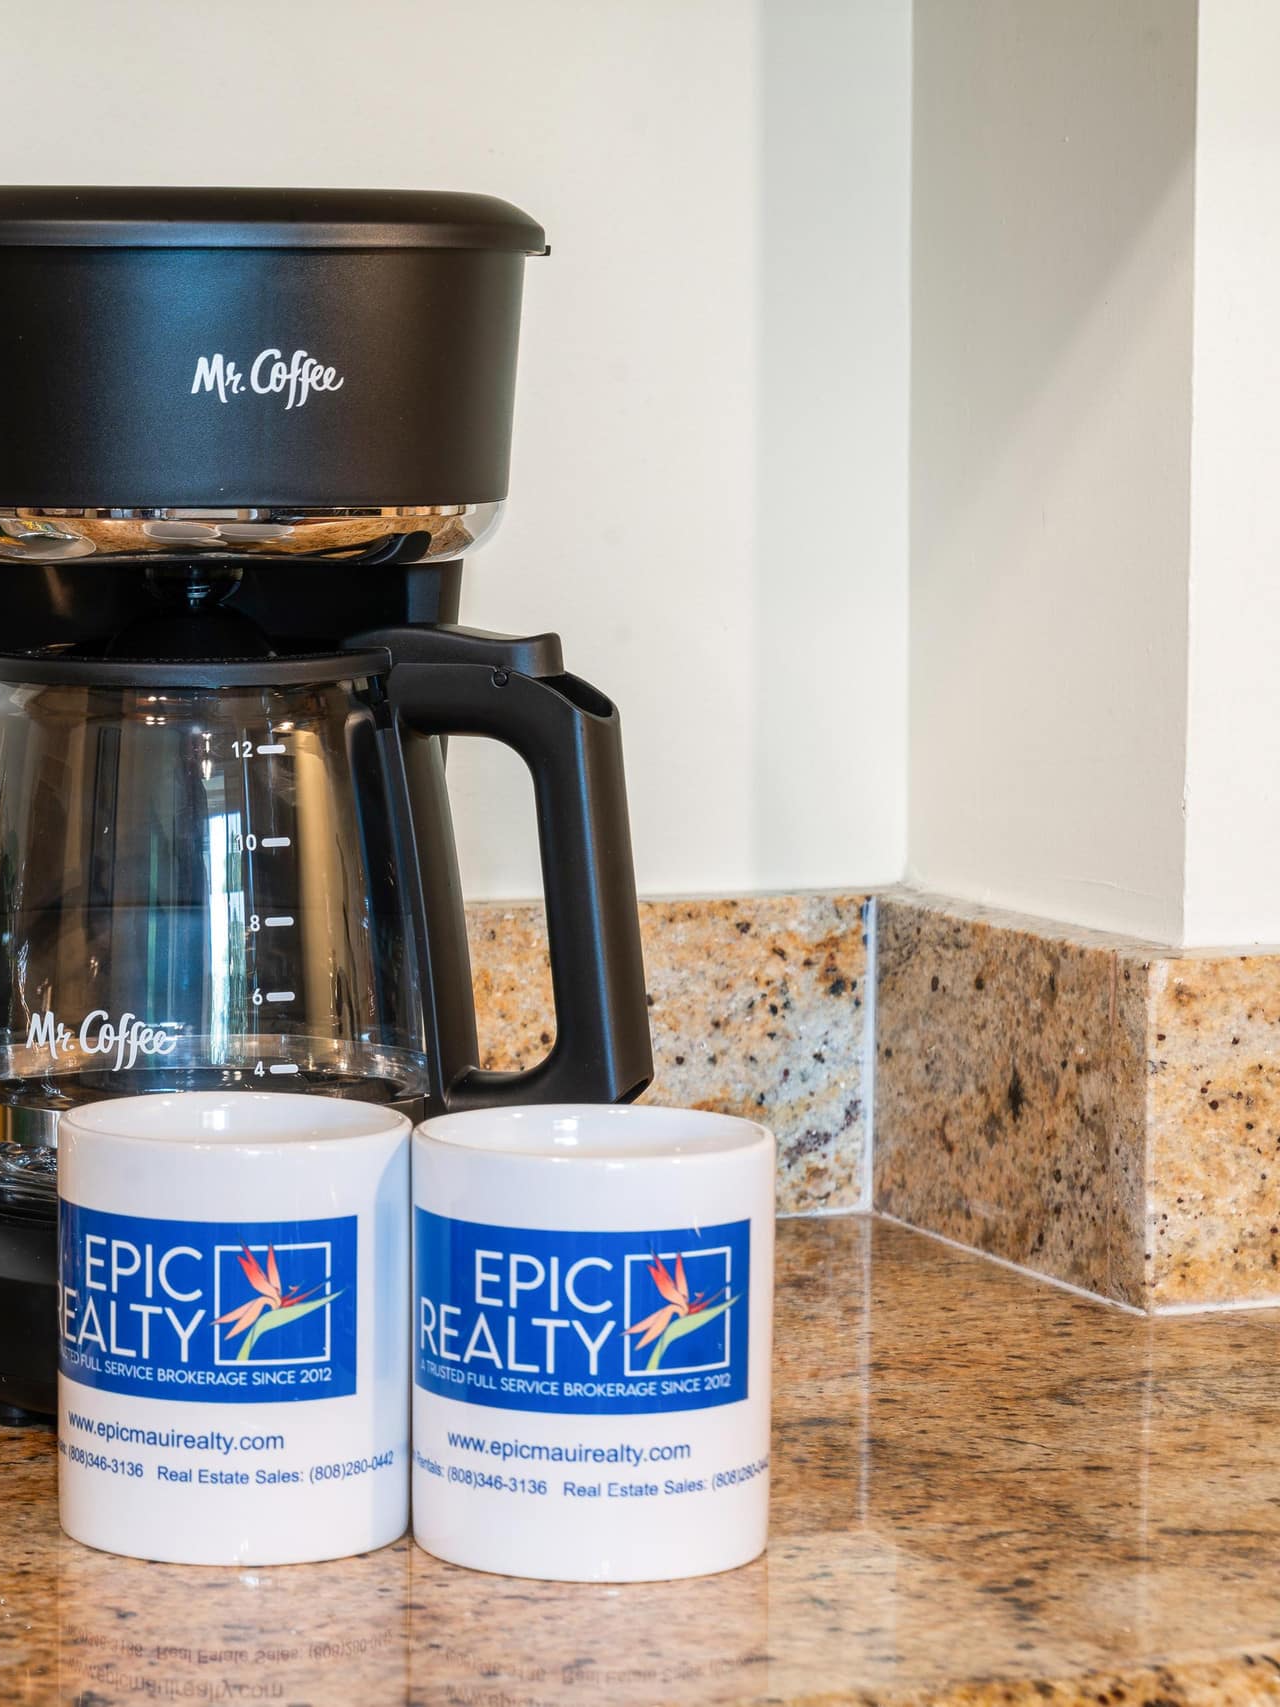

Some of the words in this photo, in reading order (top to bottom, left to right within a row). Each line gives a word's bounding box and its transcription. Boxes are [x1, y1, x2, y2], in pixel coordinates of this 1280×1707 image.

[191, 353, 246, 403] Mr.
[250, 349, 344, 410] Coffee
[231, 740, 253, 759] 12
[235, 834, 257, 851] 10
[249, 915, 260, 932] 8
[252, 989, 263, 1005] 6
[26, 1011, 75, 1060] Mr.
[79, 1010, 178, 1071] Coffee
[253, 1061, 265, 1078] 4
[85, 1234, 203, 1302] EPIC
[475, 1249, 613, 1314] EPIC
[420, 1296, 616, 1376] REALTY
[80, 1354, 102, 1373] FULL
[104, 1360, 154, 1381] SERVICE
[157, 1368, 248, 1386] BROKERAGE
[252, 1370, 296, 1386] SINCE
[299, 1366, 333, 1384] 2012
[426, 1359, 465, 1384] TRUSTED
[467, 1371, 497, 1390] FULL
[500, 1377, 559, 1396] SERVICE
[563, 1381, 658, 1398] BROKERAGE
[661, 1379, 701, 1395] SINCE
[704, 1373, 732, 1391] 2012
[68, 1410, 285, 1455] www.epicmauirealty.com
[447, 1431, 692, 1467] www.epicmauirealty.com
[68, 1442, 144, 1478] (808)346-3136
[157, 1465, 192, 1483] Real
[198, 1468, 249, 1485] Estate
[255, 1469, 304, 1484] Sales:
[309, 1450, 395, 1484] (808)280-0442
[447, 1466, 548, 1496] (808)346-3136
[563, 1479, 602, 1497] Real
[607, 1480, 659, 1498] Estate
[663, 1477, 708, 1496] Sales:
